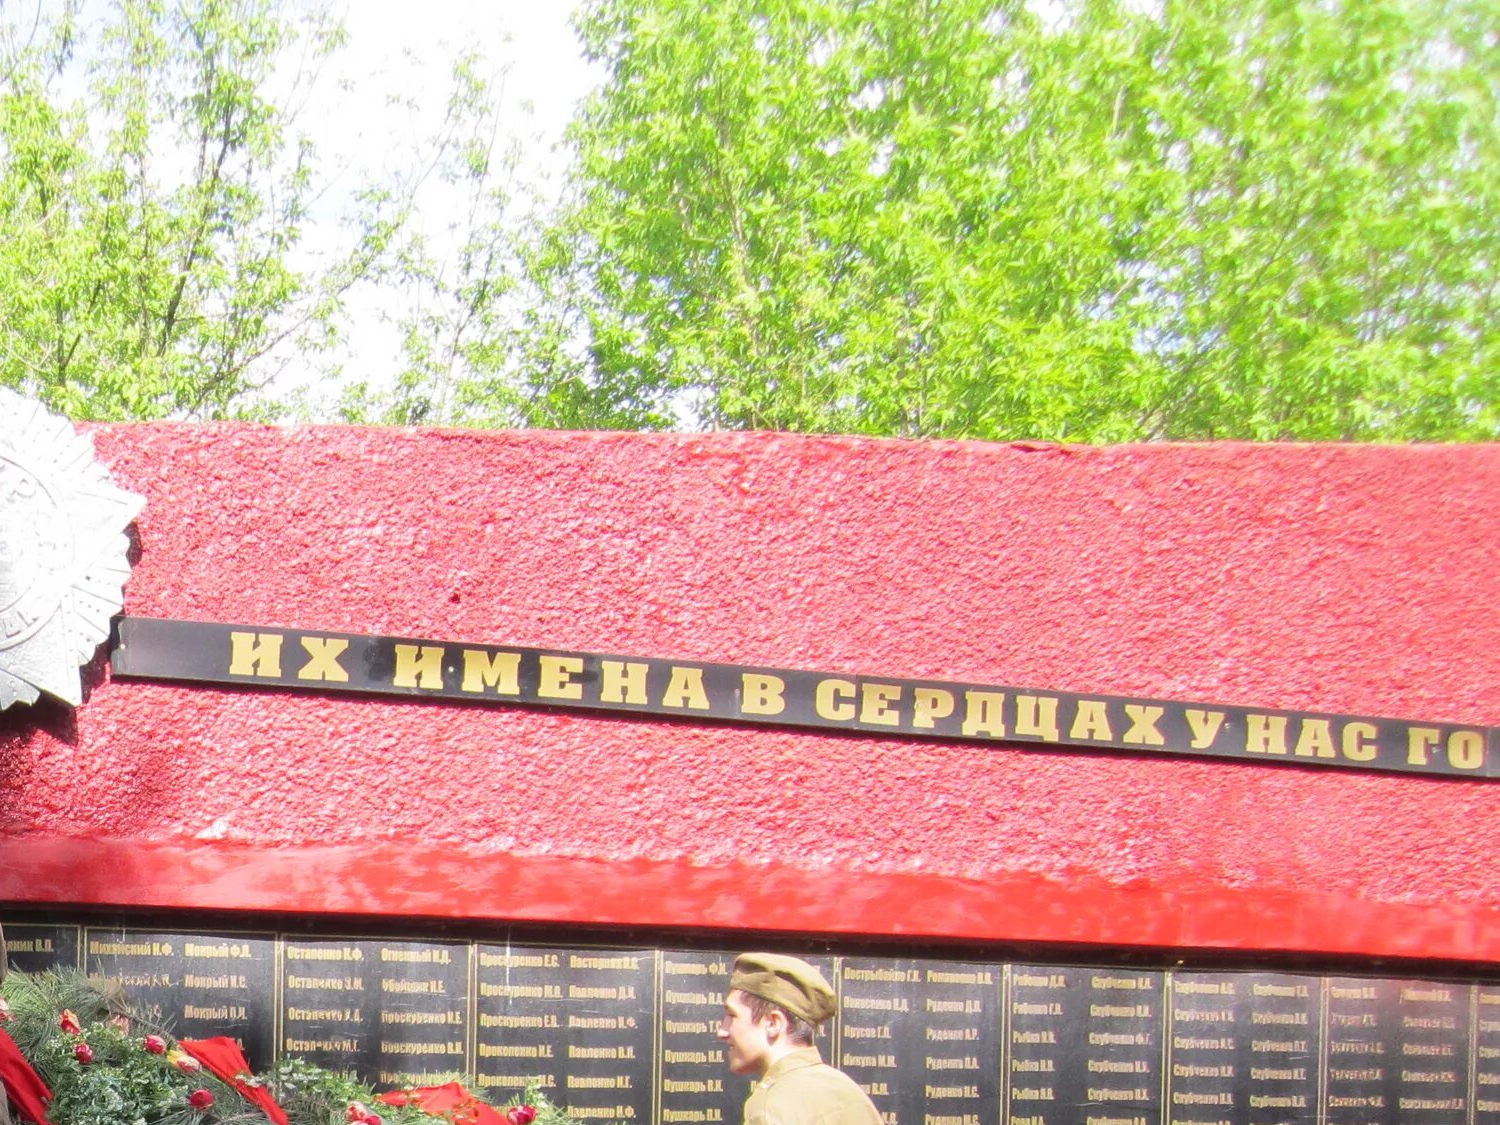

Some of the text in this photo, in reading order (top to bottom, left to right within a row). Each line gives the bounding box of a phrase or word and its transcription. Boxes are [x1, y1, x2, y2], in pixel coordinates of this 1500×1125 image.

[228, 631, 1486, 769] ИХ ИМЕНА В СЕРДЦАХ У НАС ГО
[185, 943, 229, 958] Мокрый
[287, 946, 344, 960] Остапенко
[185, 974, 229, 989] Мокрый
[185, 1005, 228, 1019] Мокрый
[666, 1020, 707, 1033] Пушкарь
[665, 1050, 706, 1063] Пушкарь
[664, 1079, 706, 1093] Пушкарь
